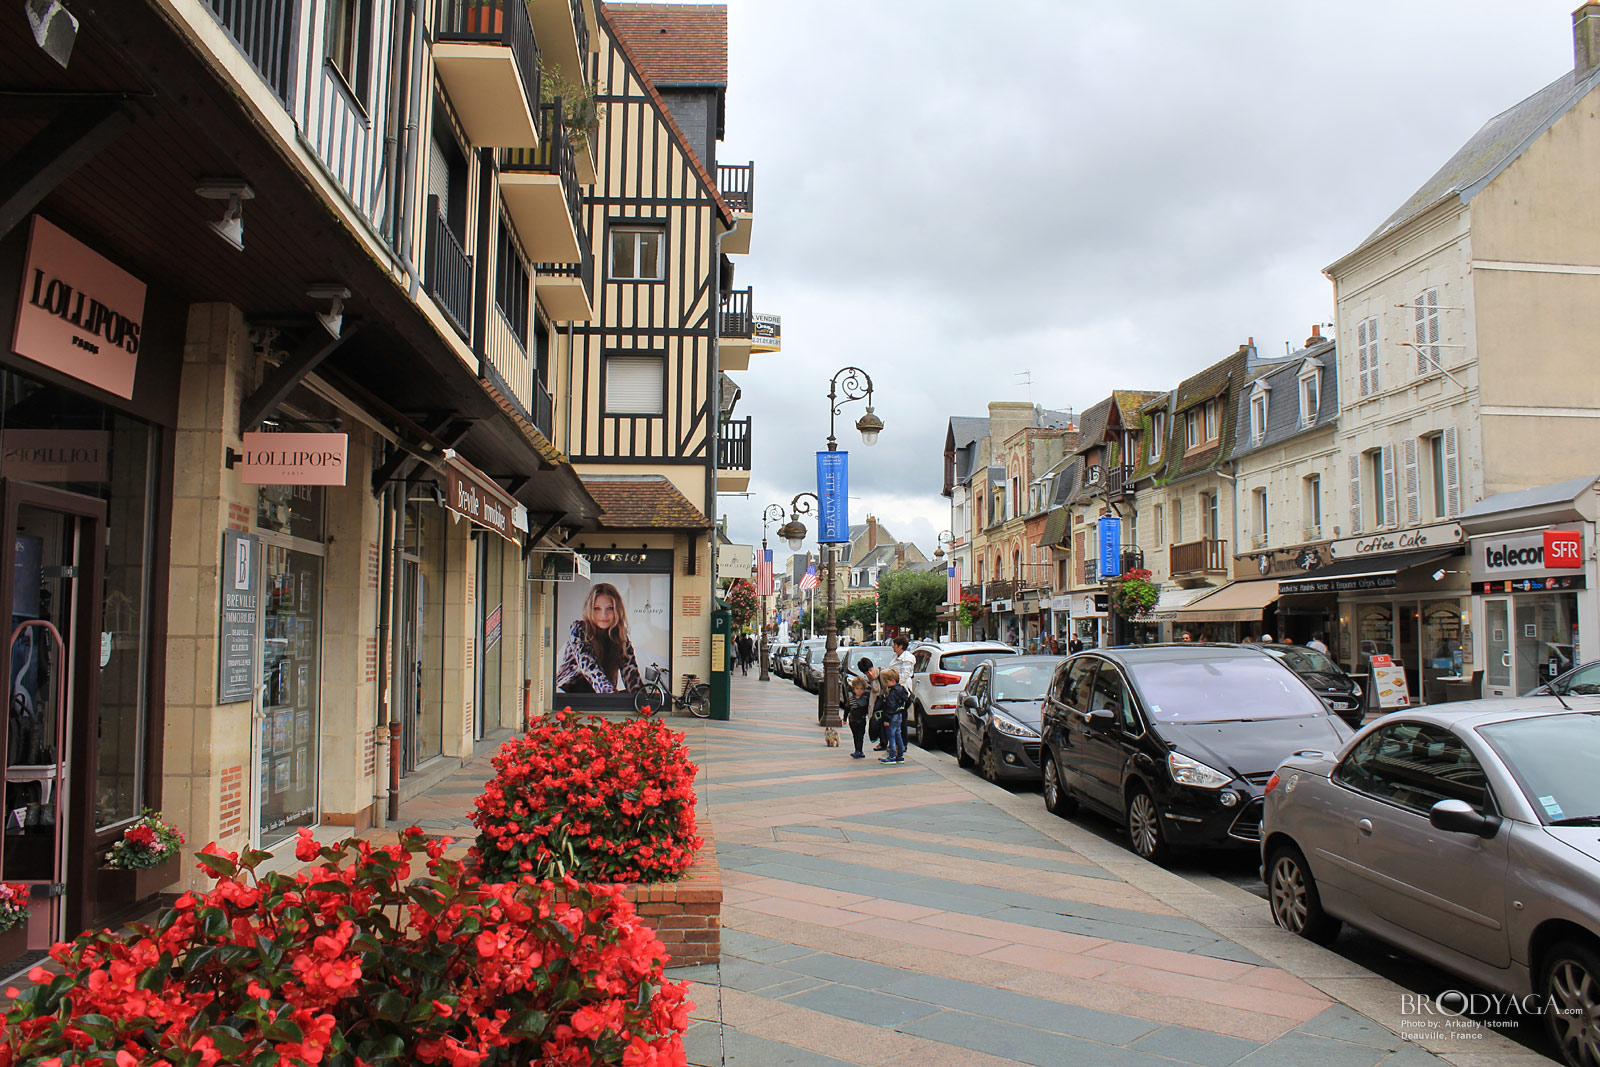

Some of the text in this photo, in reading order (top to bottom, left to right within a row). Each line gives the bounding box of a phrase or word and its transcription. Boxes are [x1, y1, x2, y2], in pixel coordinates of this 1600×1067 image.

[29, 268, 140, 354] LOLLIPOPS
[756, 315, 781, 323] VENDRE
[72, 335, 99, 354] PARIS
[246, 451, 342, 467] LOLLIPOPS
[458, 480, 480, 516] Breville
[1356, 530, 1427, 553] Coffee Cake
[1552, 541, 1578, 558] SFR
[583, 553, 611, 561] one
[226, 594, 256, 608] BREVILLE
[225, 612, 256, 624] IMMOBILIER
[716, 618, 724, 629] P
